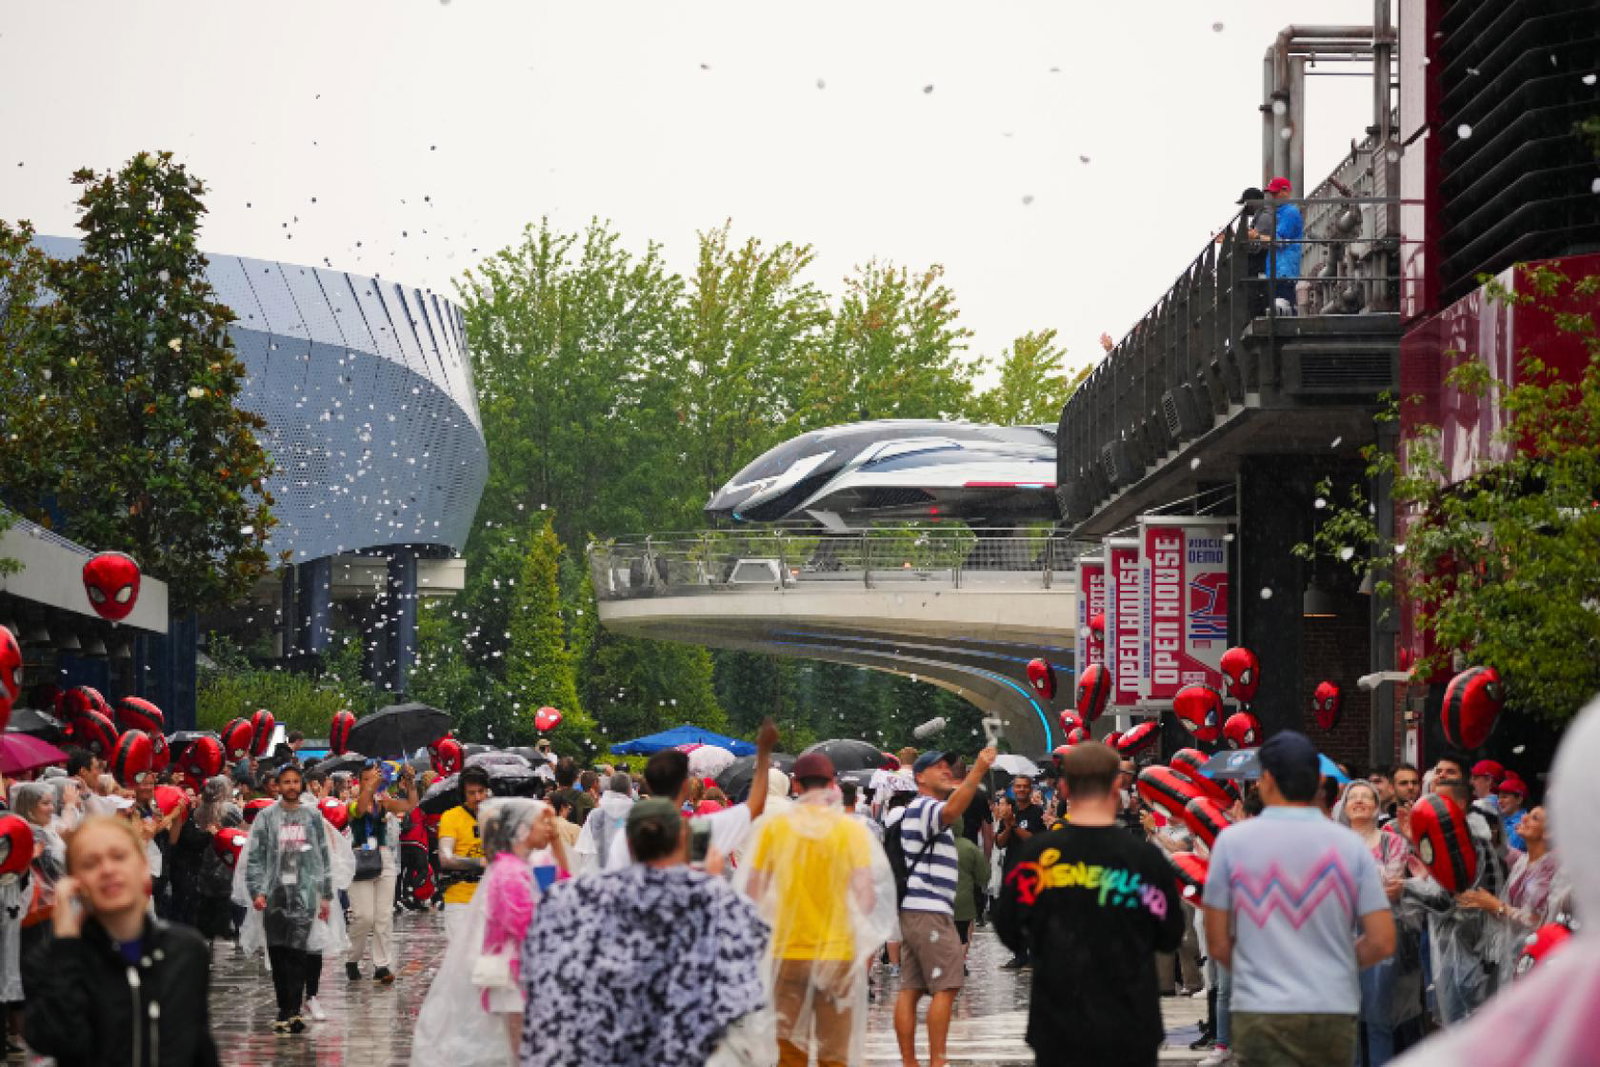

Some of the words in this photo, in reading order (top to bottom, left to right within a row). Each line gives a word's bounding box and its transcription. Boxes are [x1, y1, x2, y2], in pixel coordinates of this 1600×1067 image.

[1155, 537, 1180, 617] HOUSE
[1189, 550, 1223, 563] DEMO
[1120, 557, 1139, 630] HOUSE
[1120, 635, 1139, 691] OPEN
[1155, 621, 1180, 684] OPEN
